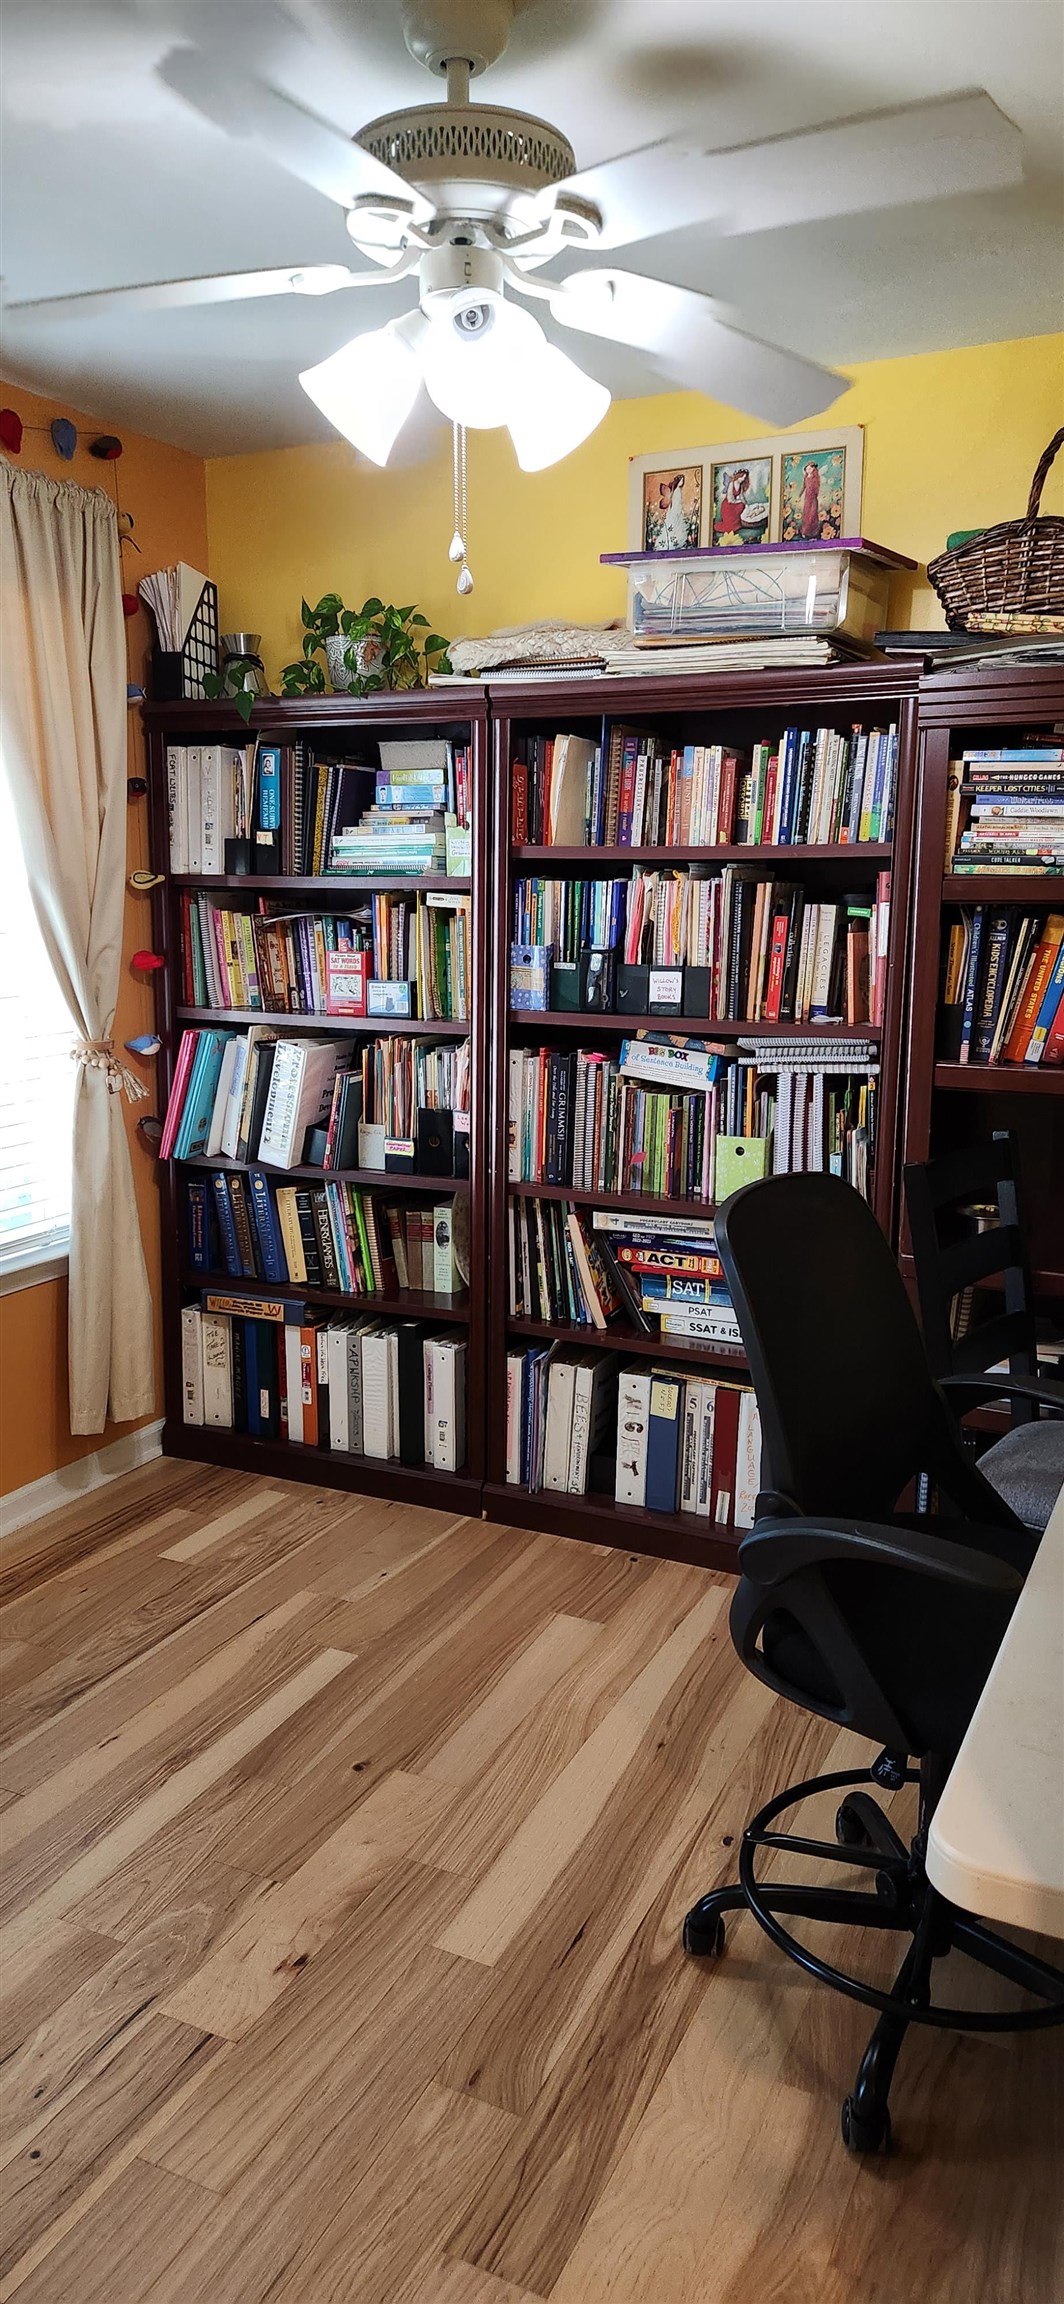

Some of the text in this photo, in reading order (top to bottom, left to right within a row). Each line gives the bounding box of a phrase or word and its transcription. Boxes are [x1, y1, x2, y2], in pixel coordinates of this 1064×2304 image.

[820, 934, 830, 990] LEGACIES
[965, 923, 982, 1012] Children's Illustrated ATLAS
[983, 963, 999, 1018] ENCYCLOPEDIA
[1025, 949, 1052, 1019] THE UNITED STATES
[648, 1046, 690, 1062] BIG BOX
[640, 1055, 674, 1068] Sentence
[674, 1059, 704, 1075] Building
[318, 1209, 335, 1269] HENRY JAMES
[646, 1253, 687, 1267] ACT
[672, 1280, 705, 1297] SAT
[688, 1306, 713, 1317] PSAT
[689, 1322, 717, 1335] SSAT
[720, 1327, 727, 1335] &
[689, 1397, 697, 1410] 5
[706, 1400, 714, 1412] 6
[573, 1392, 590, 1434] BEES
